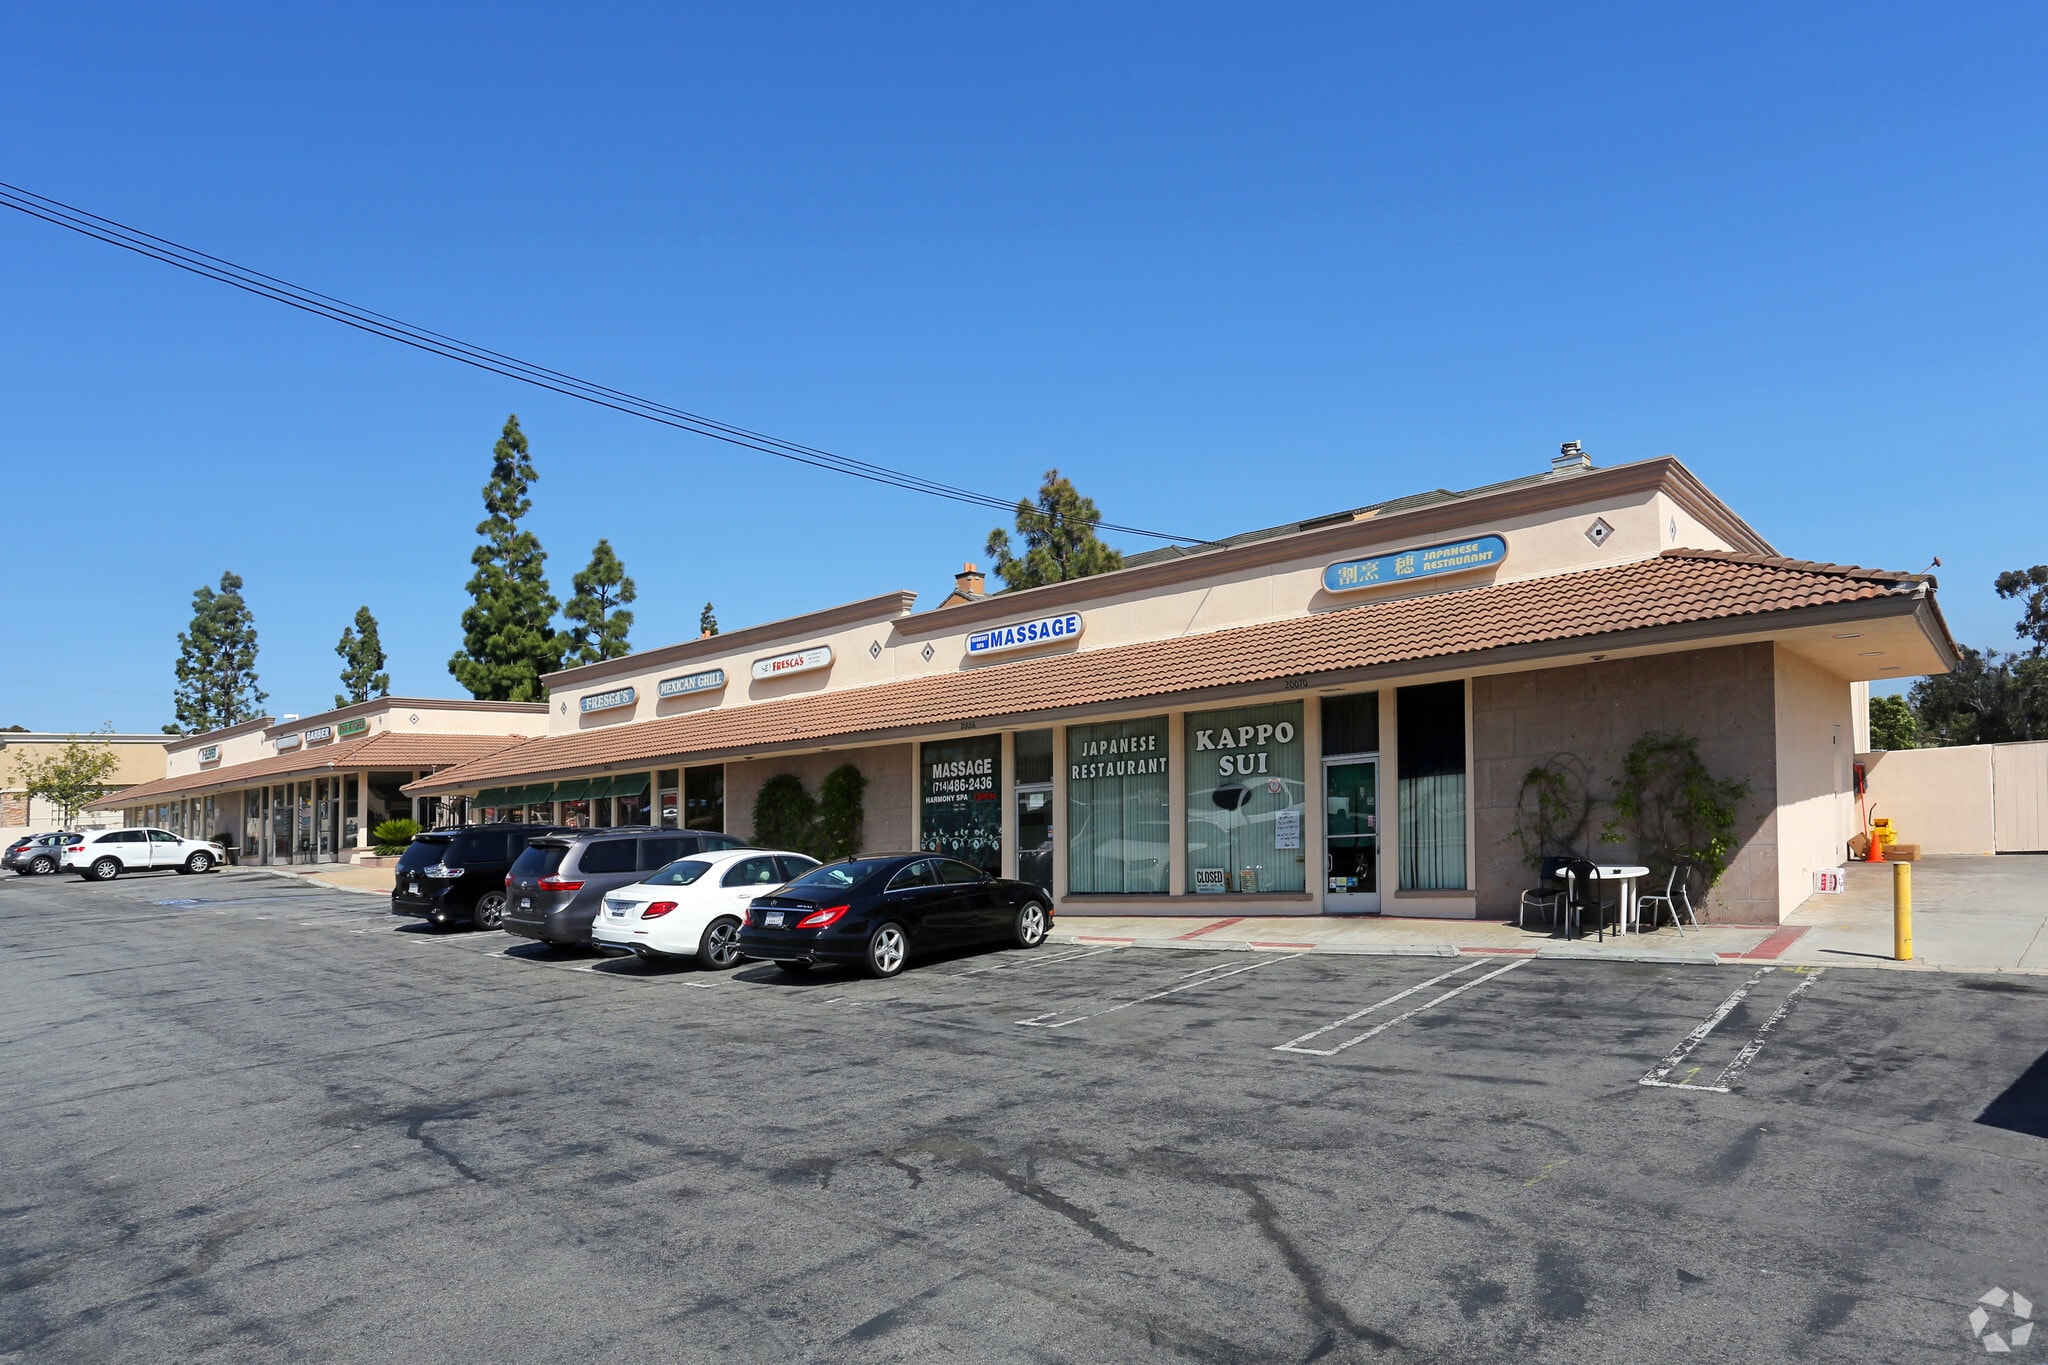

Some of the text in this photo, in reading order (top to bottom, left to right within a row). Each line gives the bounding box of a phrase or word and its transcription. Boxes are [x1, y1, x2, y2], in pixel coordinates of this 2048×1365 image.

[1423, 543, 1479, 561] JAPANESE
[1423, 551, 1494, 571] RESTAURANT
[990, 616, 1077, 648] MASSAGE
[772, 654, 804, 671] FRESCA'S
[660, 671, 722, 694] MEXICAN GRILL
[1285, 679, 1308, 689] 20070
[306, 727, 330, 741] BARBER
[1195, 721, 1294, 751] KAPPO
[1082, 735, 1156, 757] JAPANESE
[932, 758, 992, 779] MASSAGE
[1072, 757, 1167, 779] RESTAURANT
[1218, 752, 1268, 776] SUI
[925, 793, 968, 804] HARMONY SPA
[974, 792, 997, 802] OPEN
[1196, 870, 1223, 884] CLOSED
